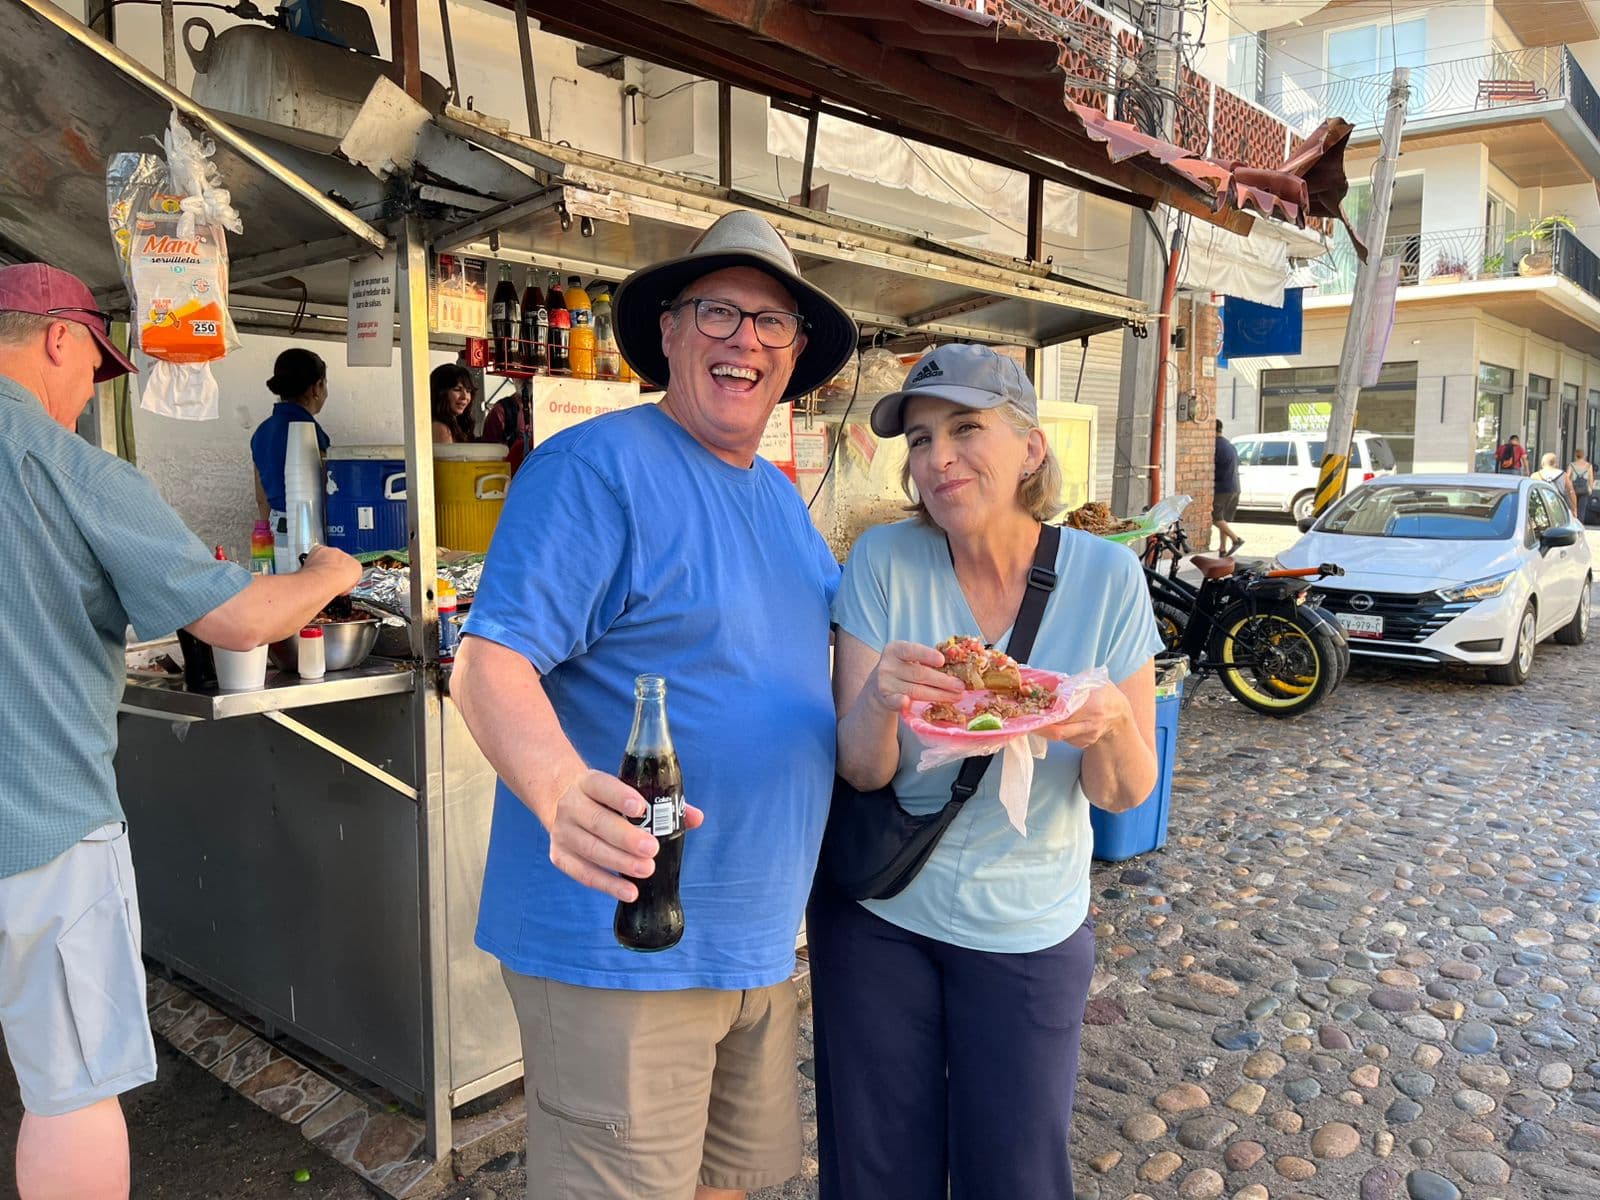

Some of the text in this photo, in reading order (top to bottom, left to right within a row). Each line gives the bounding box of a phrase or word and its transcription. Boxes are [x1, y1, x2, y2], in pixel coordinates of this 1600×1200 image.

[152, 256, 200, 264] servilletas
[194, 324, 215, 332] 250
[912, 370, 944, 384] adidas
[549, 402, 592, 414] Ordene
